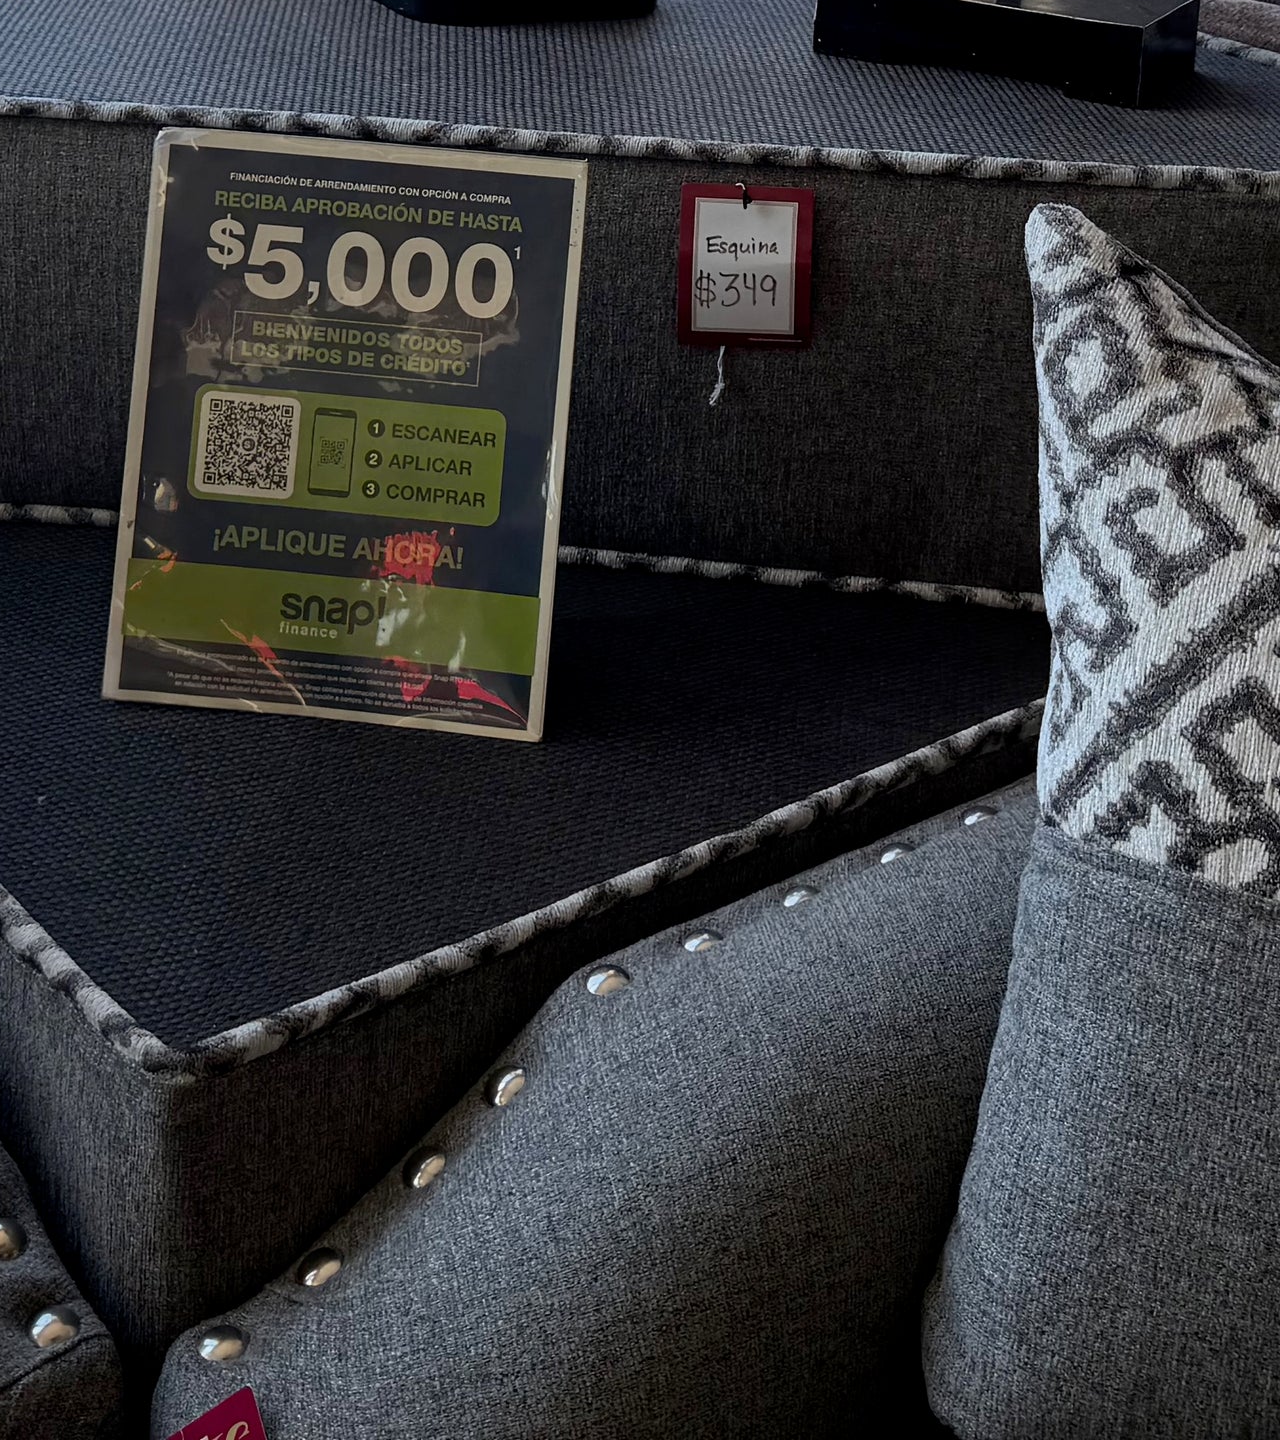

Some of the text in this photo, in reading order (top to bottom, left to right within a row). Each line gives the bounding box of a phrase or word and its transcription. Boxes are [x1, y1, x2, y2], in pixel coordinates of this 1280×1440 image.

[230, 172, 512, 205] FINANCIACIÓN DE ARRENDAMIENTO CON OPCIÓN A COMPRA
[214, 190, 523, 233] RECIBA APROBACIÓN DE HASTA
[706, 235, 779, 261] Esquina
[694, 269, 778, 309] $349
[252, 320, 464, 355] BIENVENIDOS TODOS
[241, 340, 280, 358] LOS
[284, 344, 343, 365] TIPOS
[347, 348, 375, 368] DE
[391, 423, 497, 448] ESCANEAR
[388, 454, 473, 477] APLICAR
[386, 484, 486, 508] COMPRAR
[213, 524, 464, 570] ¡APLIQUE AHORA!
[279, 621, 338, 639] finance
